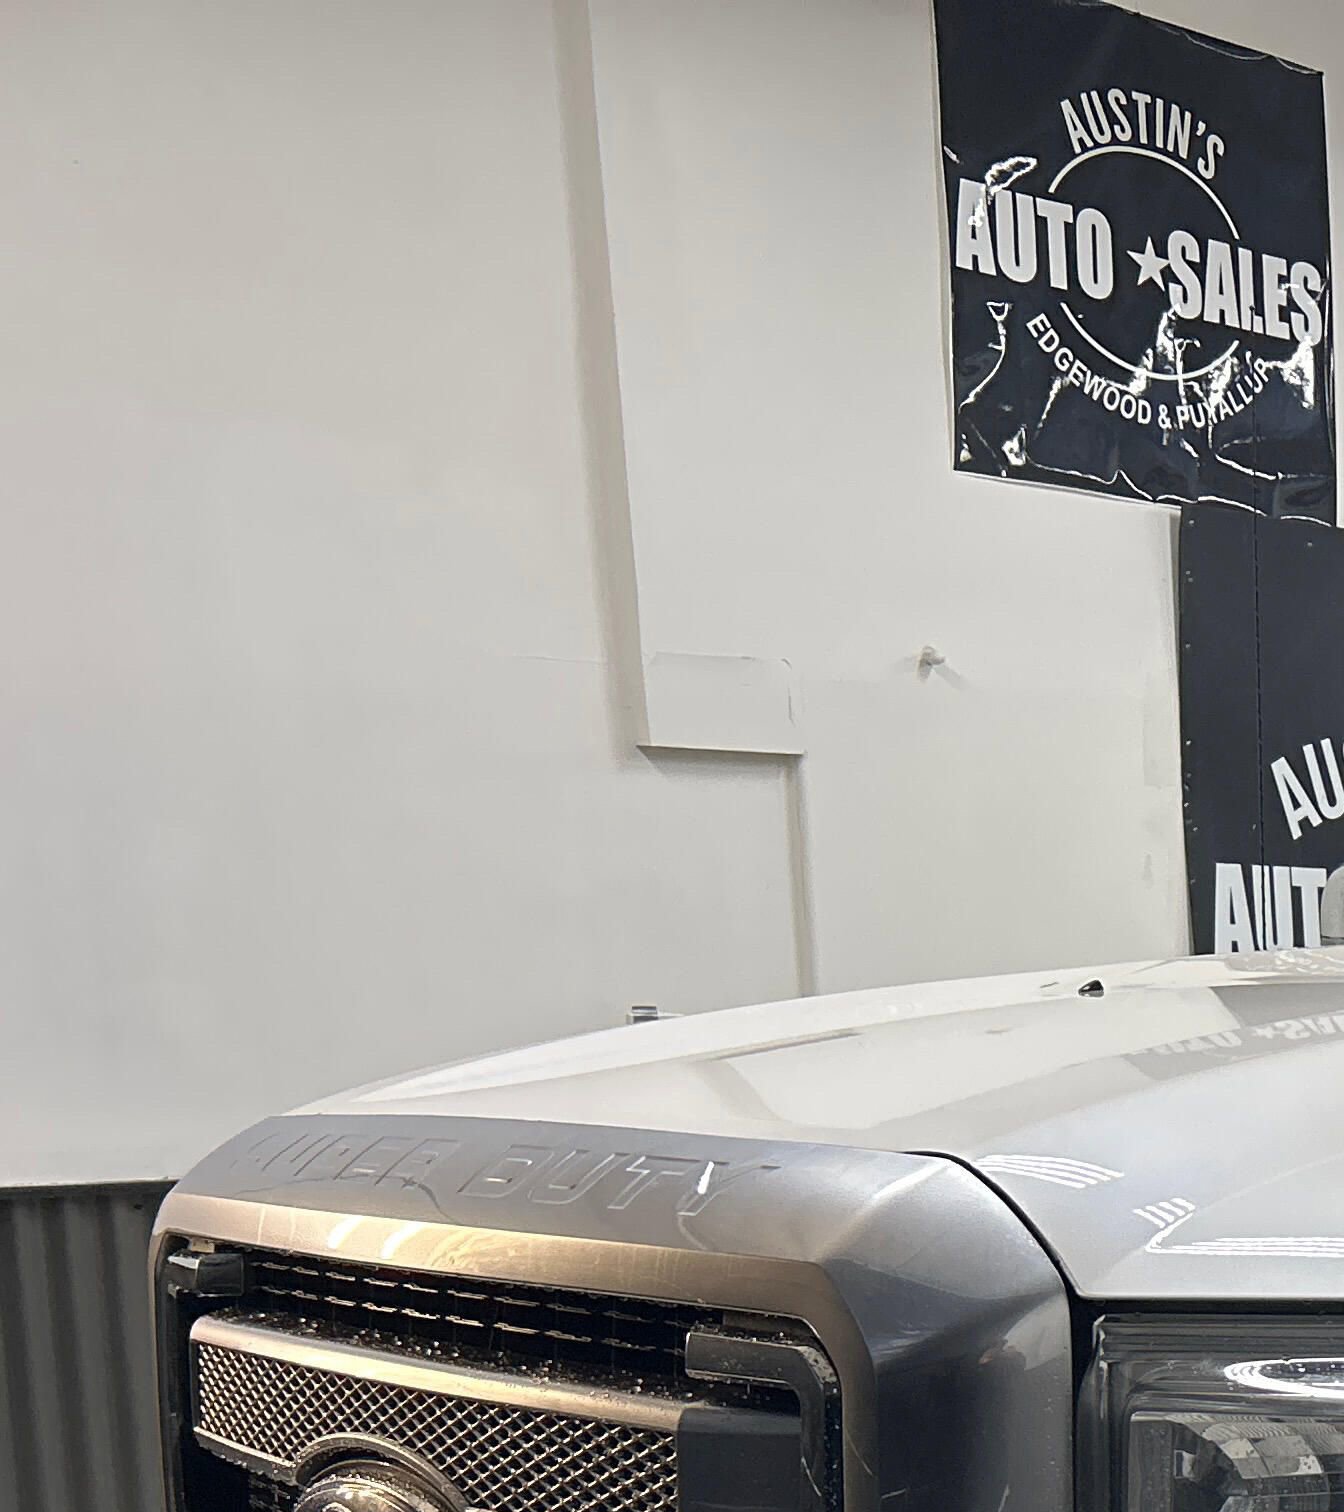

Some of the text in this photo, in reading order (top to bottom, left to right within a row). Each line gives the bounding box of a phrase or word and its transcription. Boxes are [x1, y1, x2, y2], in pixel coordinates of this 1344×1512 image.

[1060, 87, 1225, 180] AUSTIN'S
[956, 178, 1323, 346] AUTO SALES
[1026, 312, 1269, 430] EDGEWOOD & PUYALLUP
[1214, 862, 1328, 954] AUT
[456, 1144, 782, 1217] DUTY
